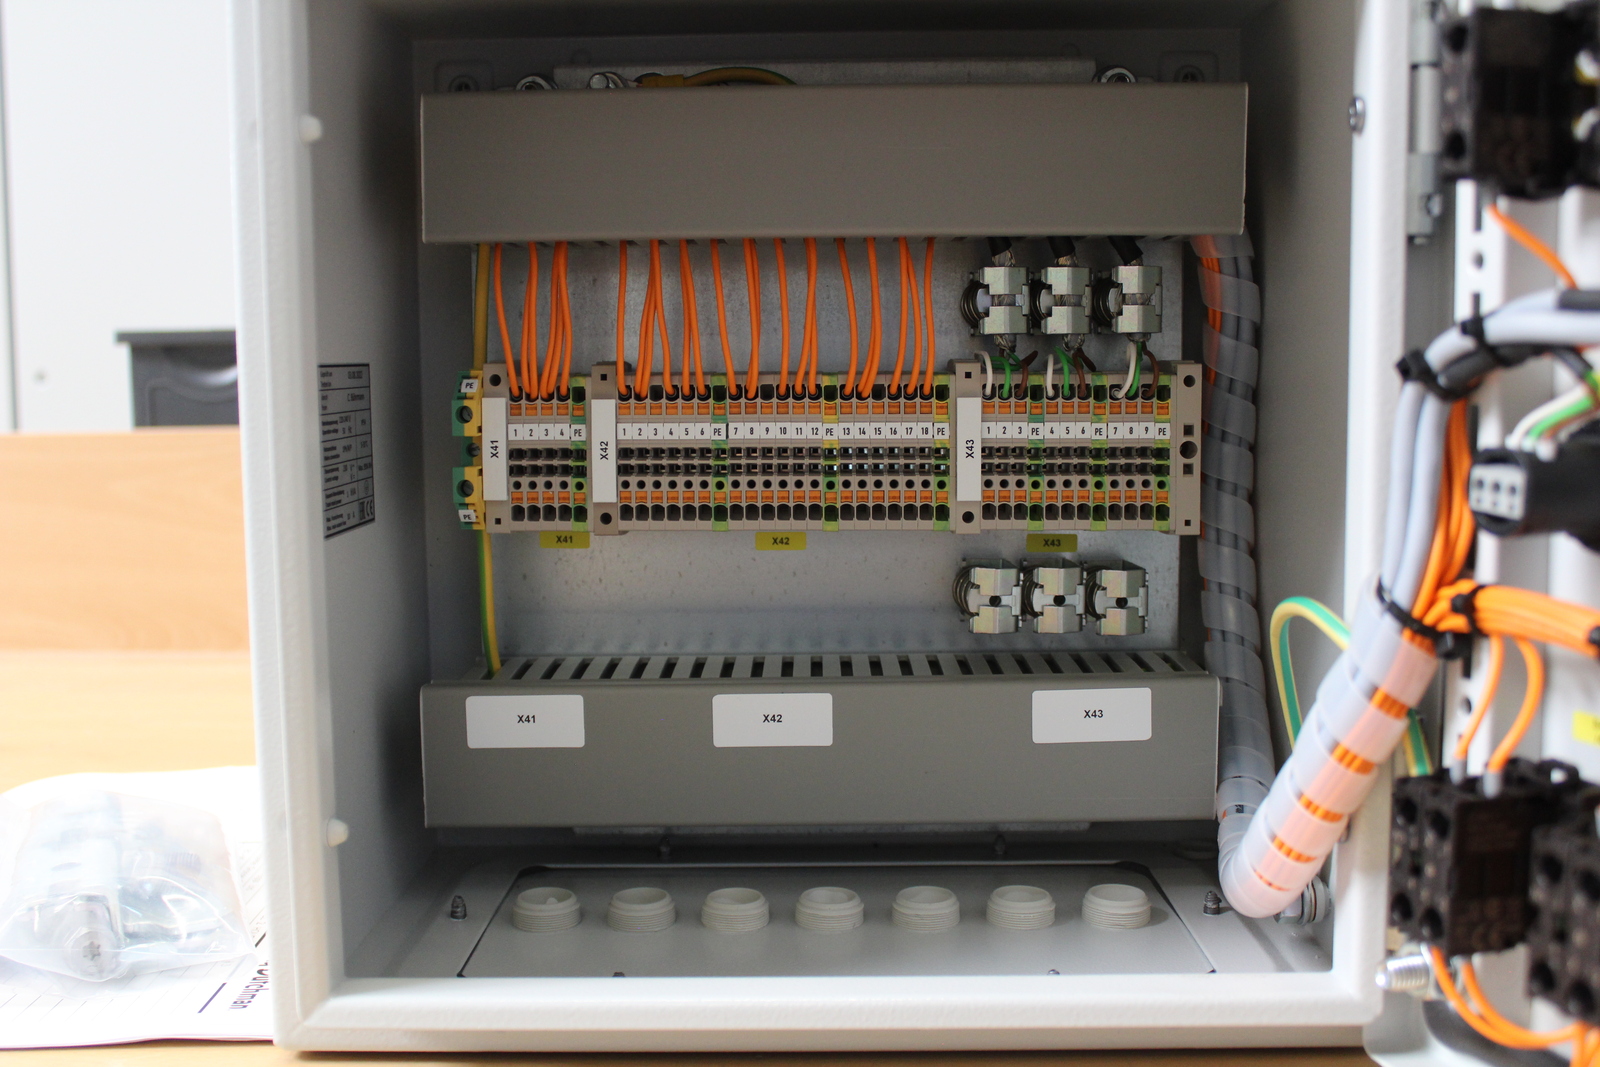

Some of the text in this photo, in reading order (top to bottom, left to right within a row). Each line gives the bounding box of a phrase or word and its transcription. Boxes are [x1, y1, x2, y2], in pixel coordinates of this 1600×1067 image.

[573, 428, 583, 438] PE
[713, 427, 722, 437] PE
[779, 426, 787, 436] 10
[795, 427, 803, 436] 11
[811, 426, 819, 436] 12
[825, 427, 834, 437] PE
[842, 426, 946, 436] 13 14 15 16 17 18 PE
[1031, 427, 1040, 436] PE
[1094, 427, 1103, 436] PE
[1157, 427, 1167, 436] PE
[489, 440, 499, 459] X41
[599, 440, 609, 461] X42
[965, 439, 975, 459] X43
[555, 535, 573, 544] X41
[772, 536, 790, 546] X42
[1042, 538, 1062, 548] X43
[517, 714, 536, 724] X41
[762, 713, 783, 723] X42
[1083, 709, 1104, 719] X43
